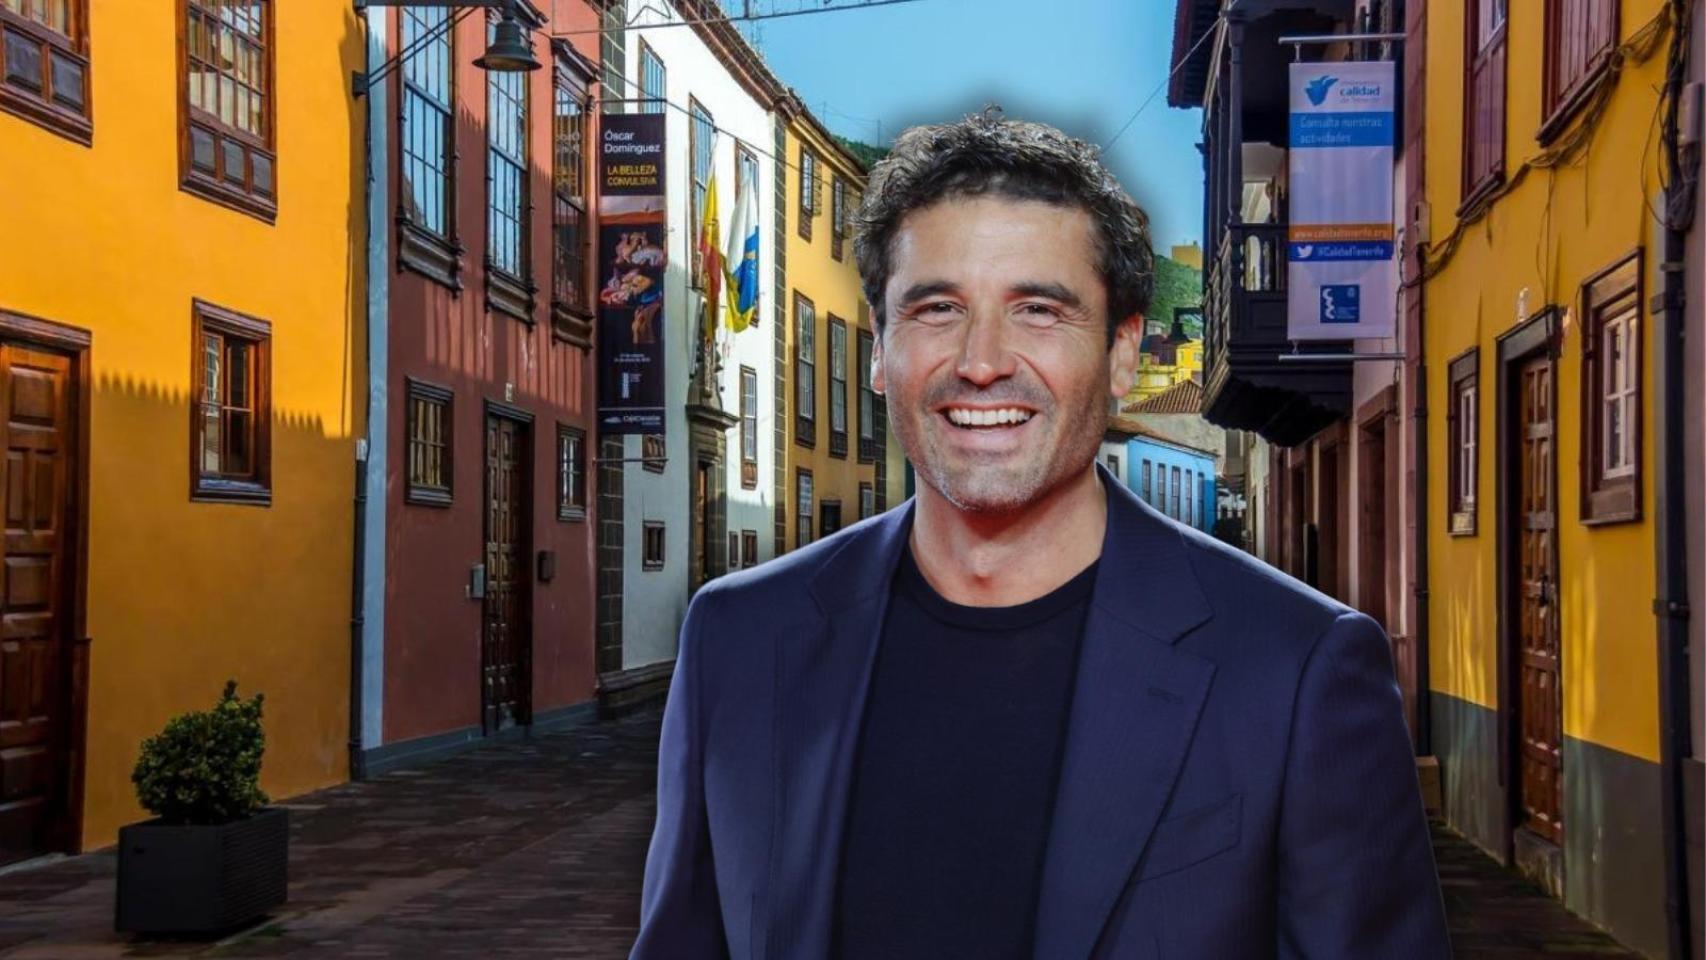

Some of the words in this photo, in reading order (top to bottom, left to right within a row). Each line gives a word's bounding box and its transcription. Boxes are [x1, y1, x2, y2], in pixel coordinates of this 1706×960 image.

[1339, 86, 1380, 97] calidad
[1300, 116, 1340, 129] Consulta
[1342, 117, 1383, 128] nuestras
[604, 129, 635, 141] Óscar
[604, 143, 661, 155] Domínguez
[607, 165, 618, 175] LA
[619, 164, 657, 175] BELLEZA
[607, 176, 657, 186] CONVULSIVA
